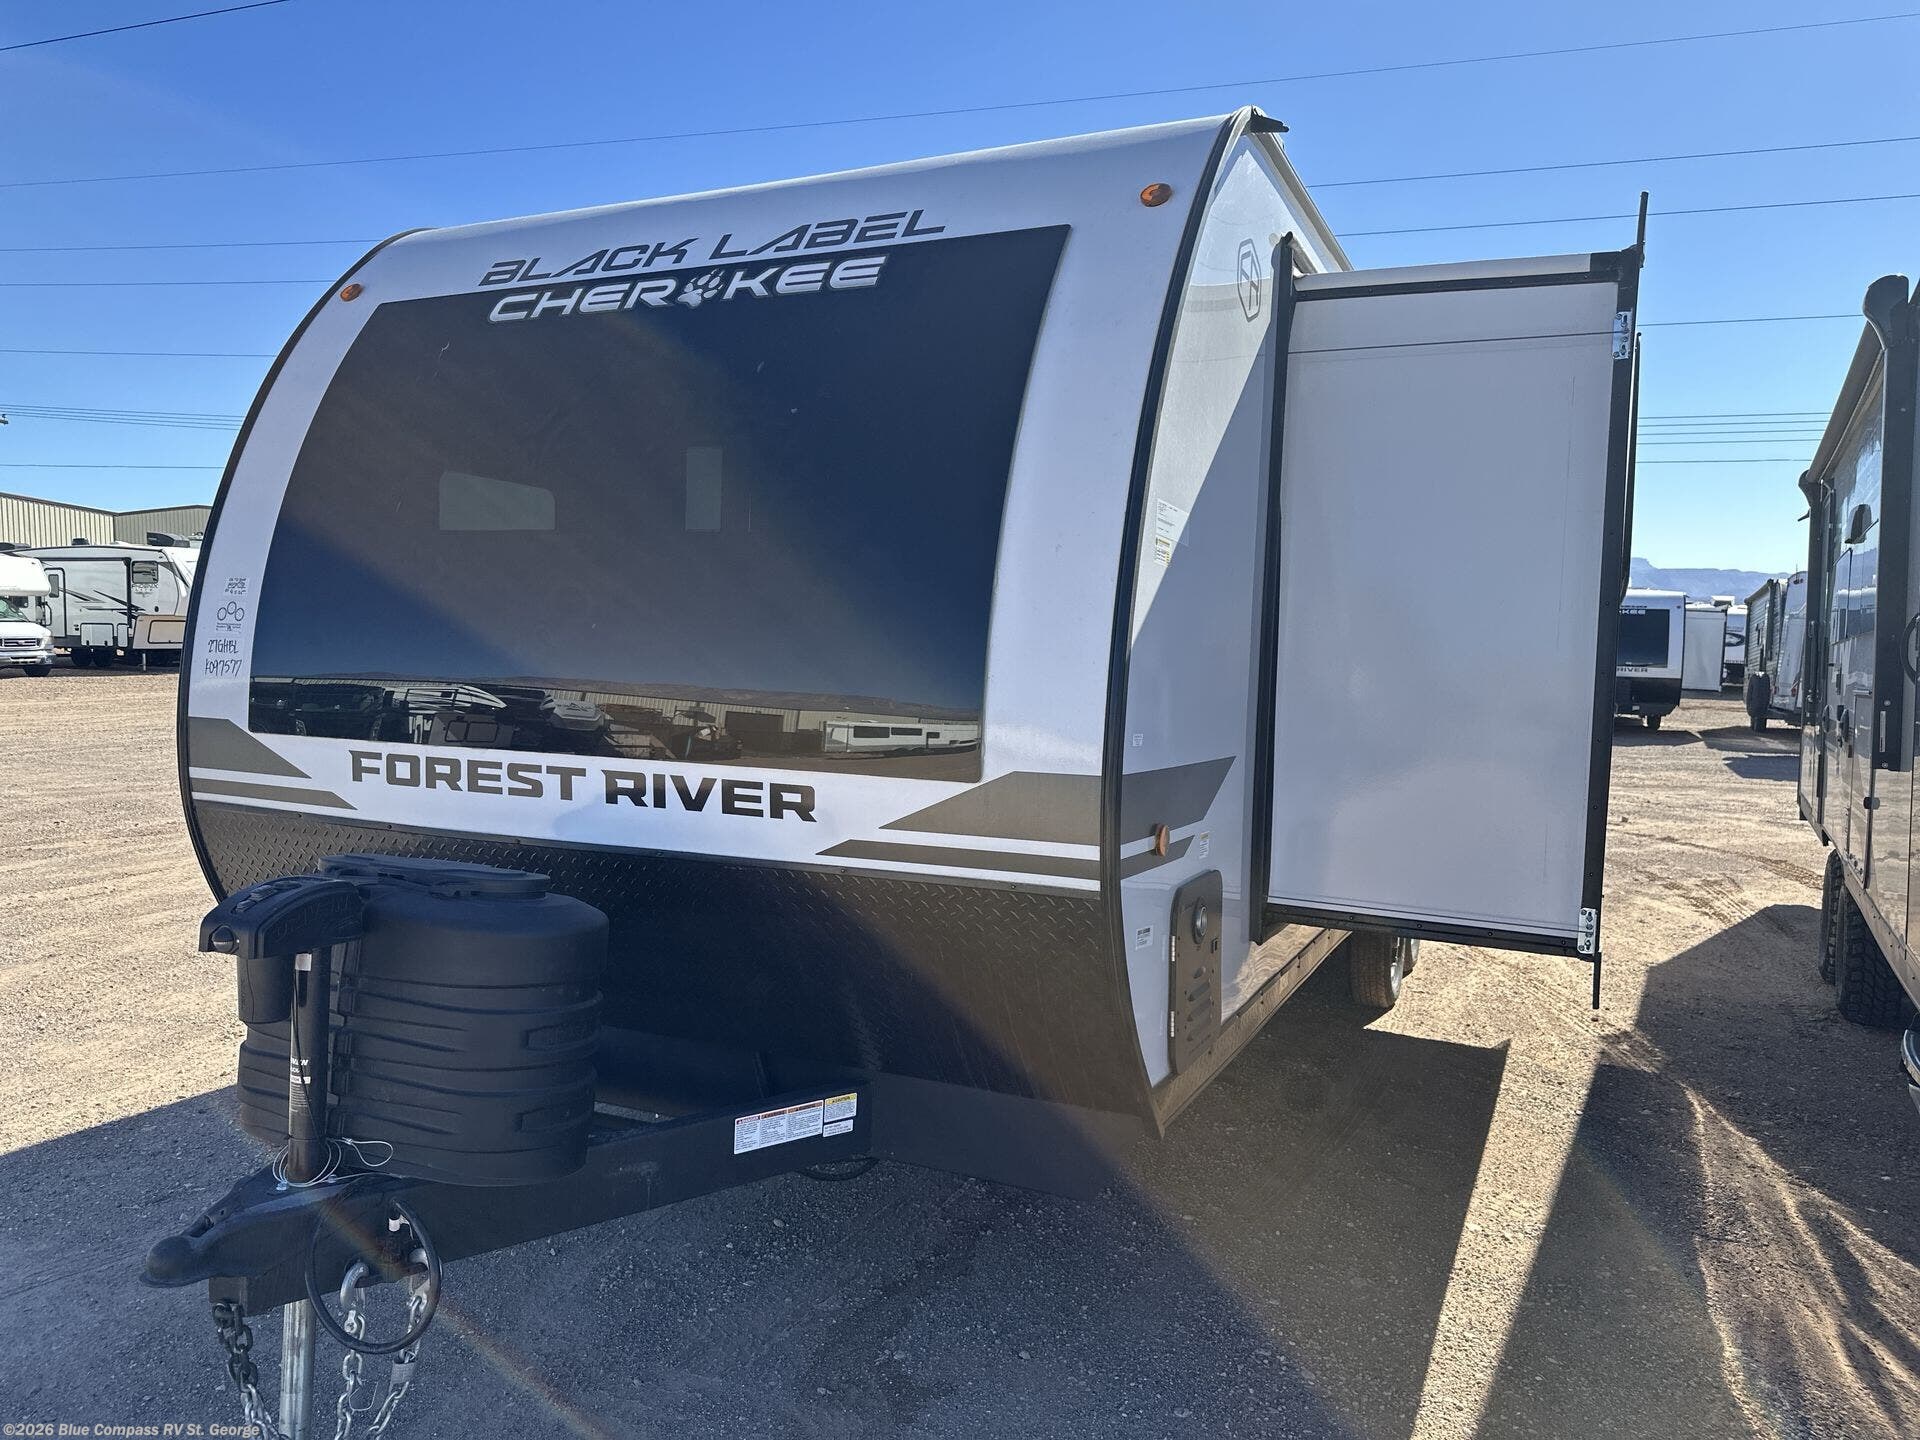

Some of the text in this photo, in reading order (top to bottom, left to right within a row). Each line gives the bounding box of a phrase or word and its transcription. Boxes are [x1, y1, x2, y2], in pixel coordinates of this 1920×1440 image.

[478, 209, 946, 287] BLACK LABEL
[348, 749, 818, 823] FOREST RIVER
